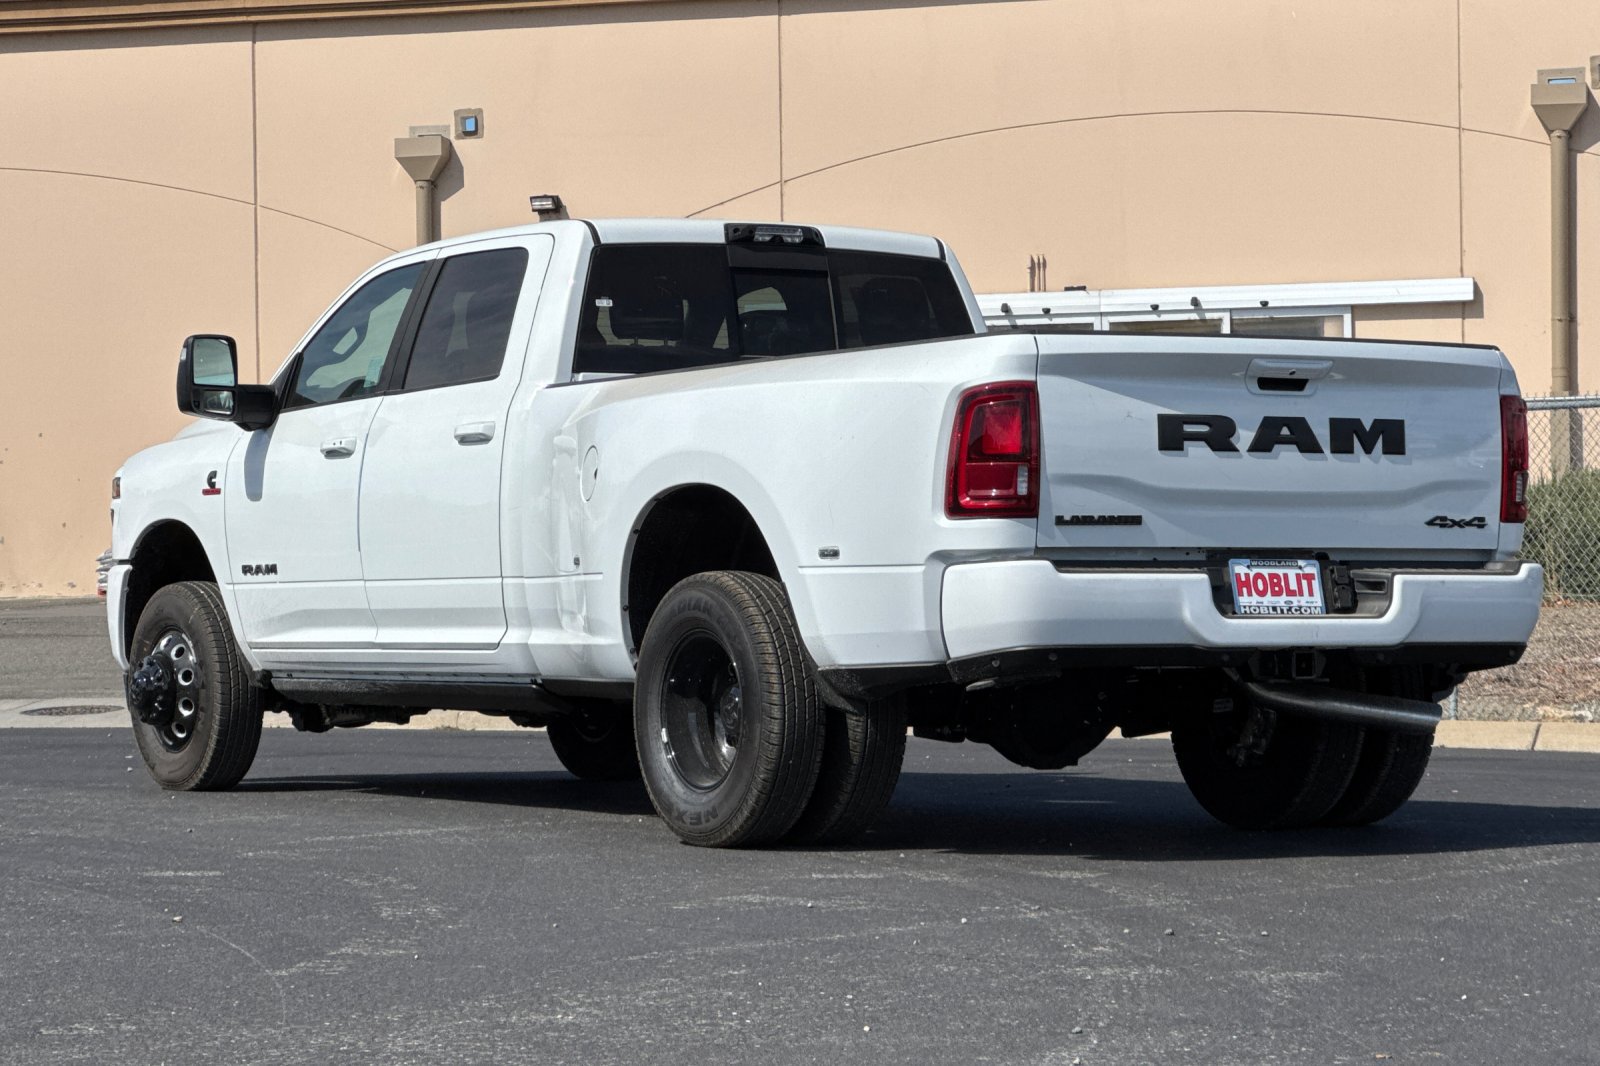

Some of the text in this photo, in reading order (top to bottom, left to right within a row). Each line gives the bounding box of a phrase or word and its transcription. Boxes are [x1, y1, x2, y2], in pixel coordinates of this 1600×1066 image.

[1158, 413, 1406, 455] RAM
[1424, 515, 1488, 530] 4x4
[242, 564, 277, 577] RAM
[1235, 572, 1316, 597] HOBLIT
[1241, 605, 1322, 615] HOBLIT.COM
